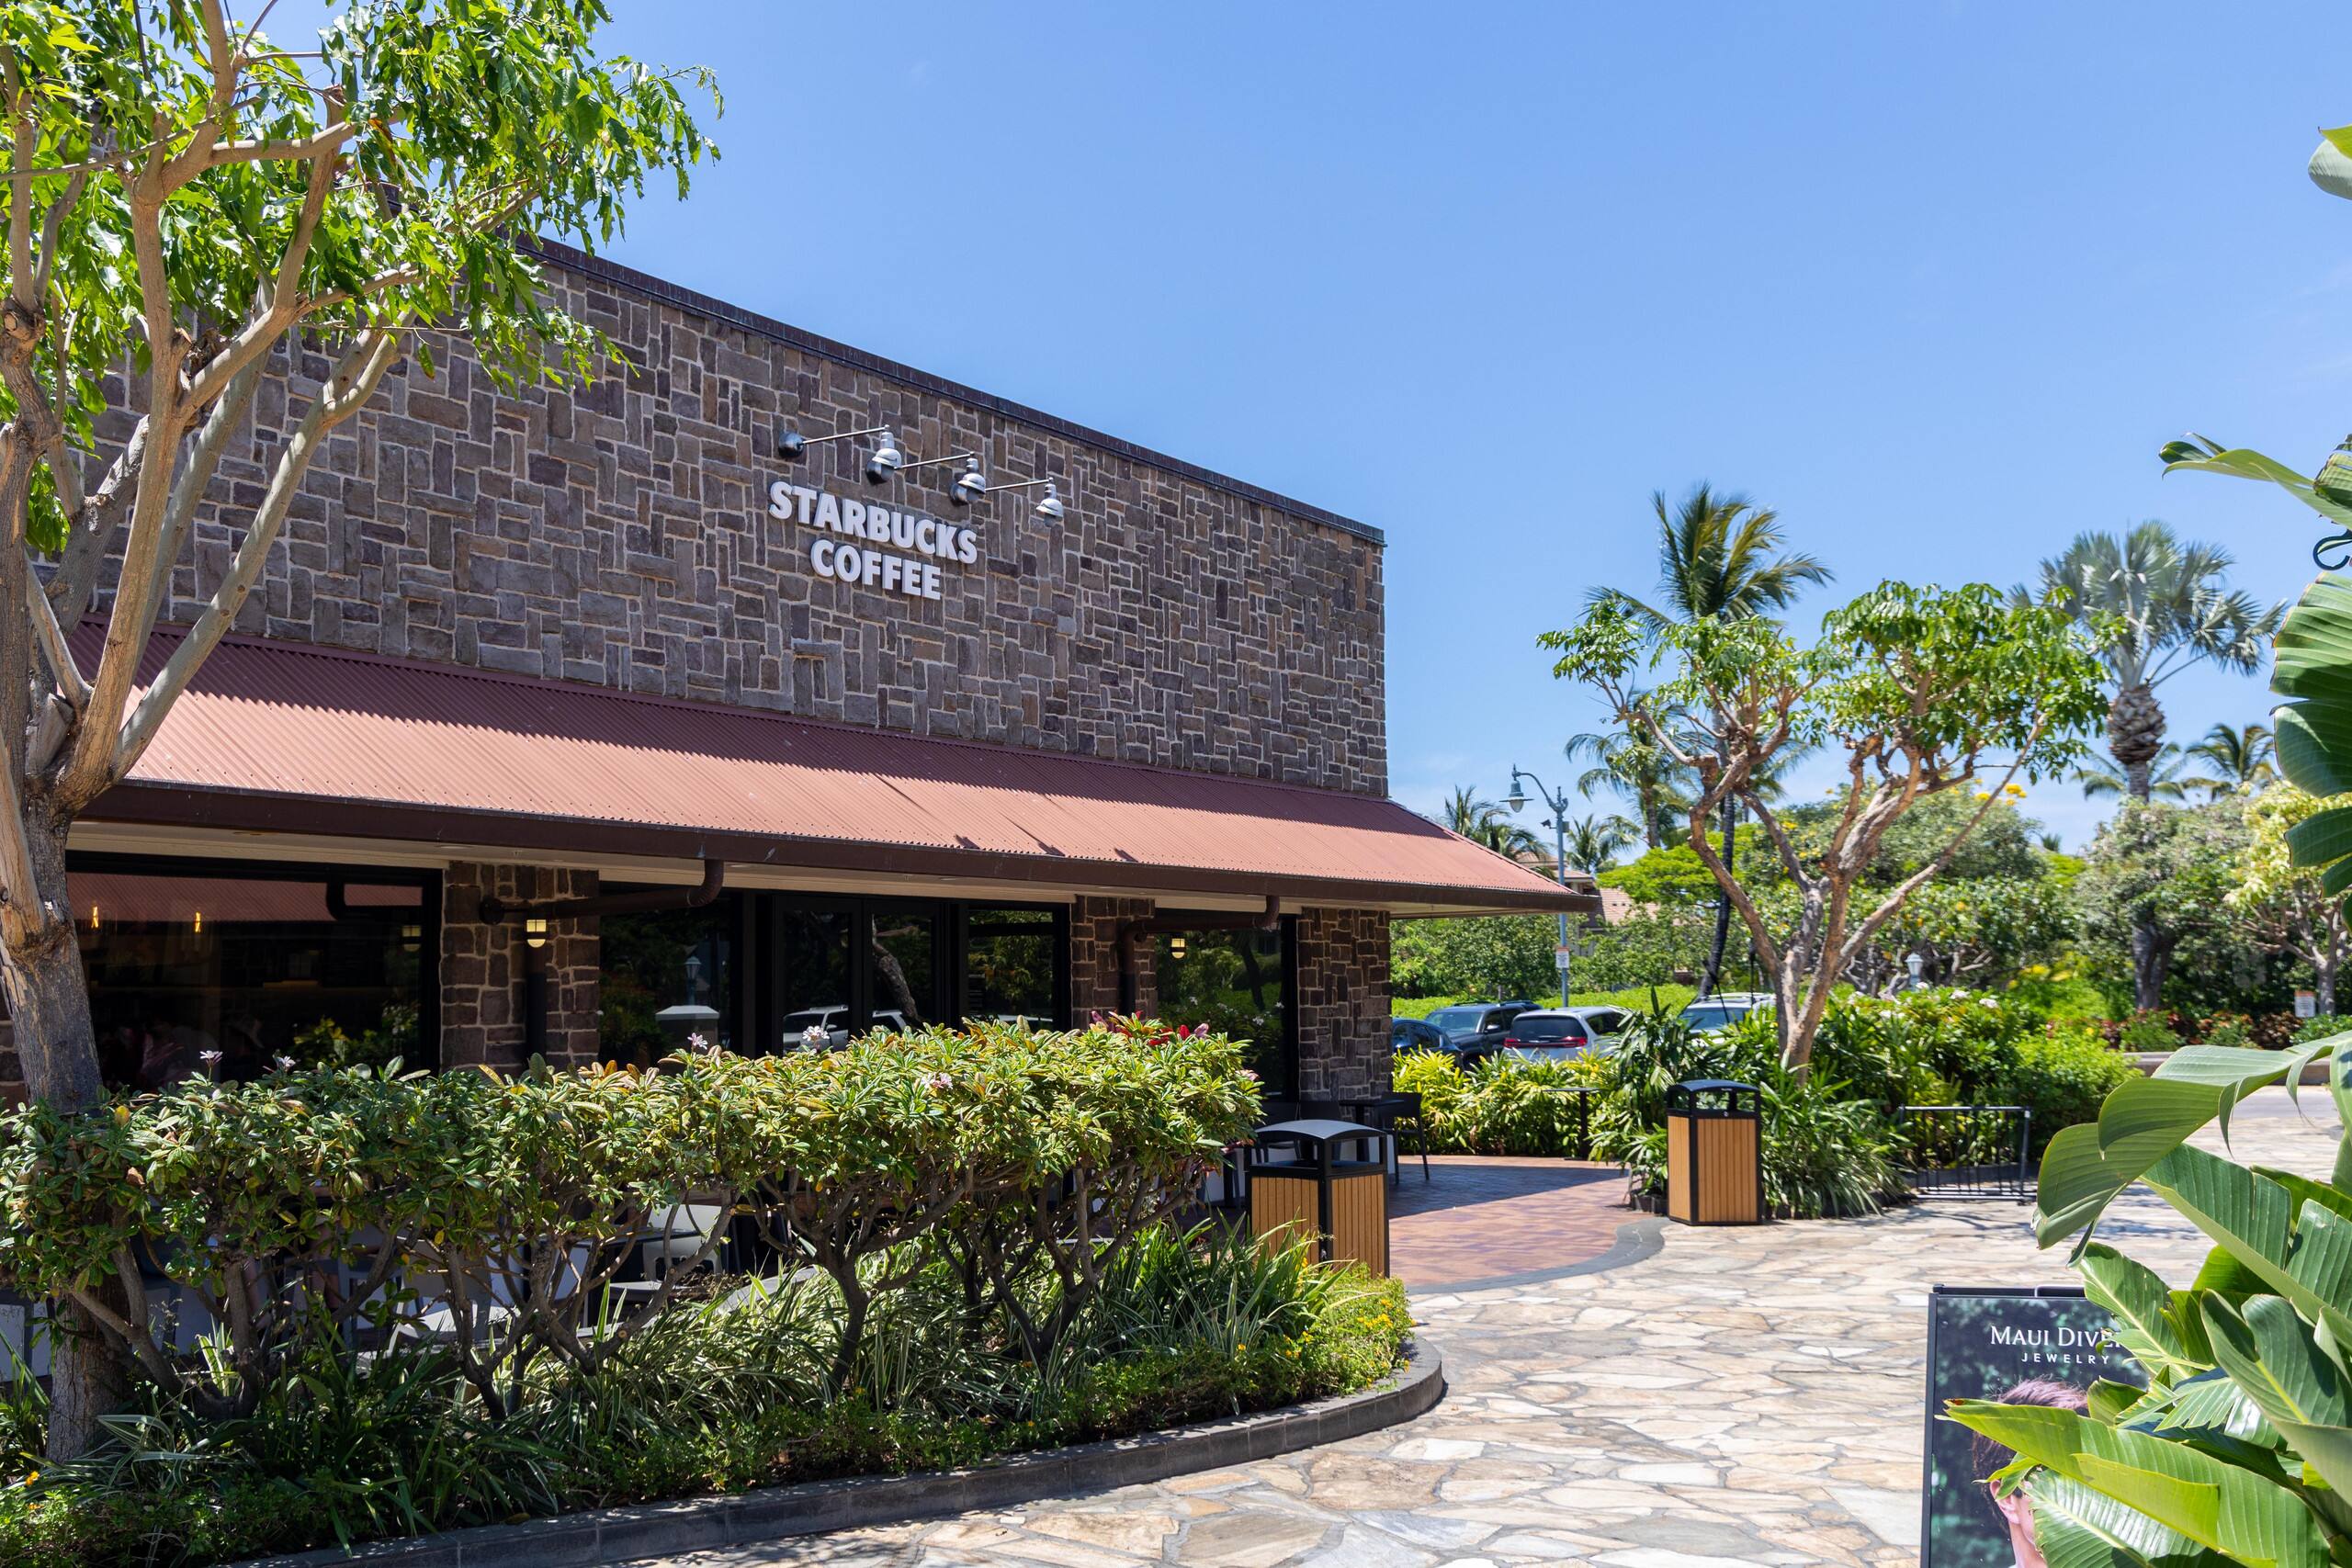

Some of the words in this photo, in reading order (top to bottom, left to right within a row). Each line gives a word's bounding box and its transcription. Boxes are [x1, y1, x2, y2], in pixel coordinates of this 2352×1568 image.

[769, 481, 978, 564] STARBUCKS
[811, 539, 941, 600] COFFEE
[1990, 1325, 2050, 1346] MAUI
[2021, 1352, 2109, 1364] JEWELRY
